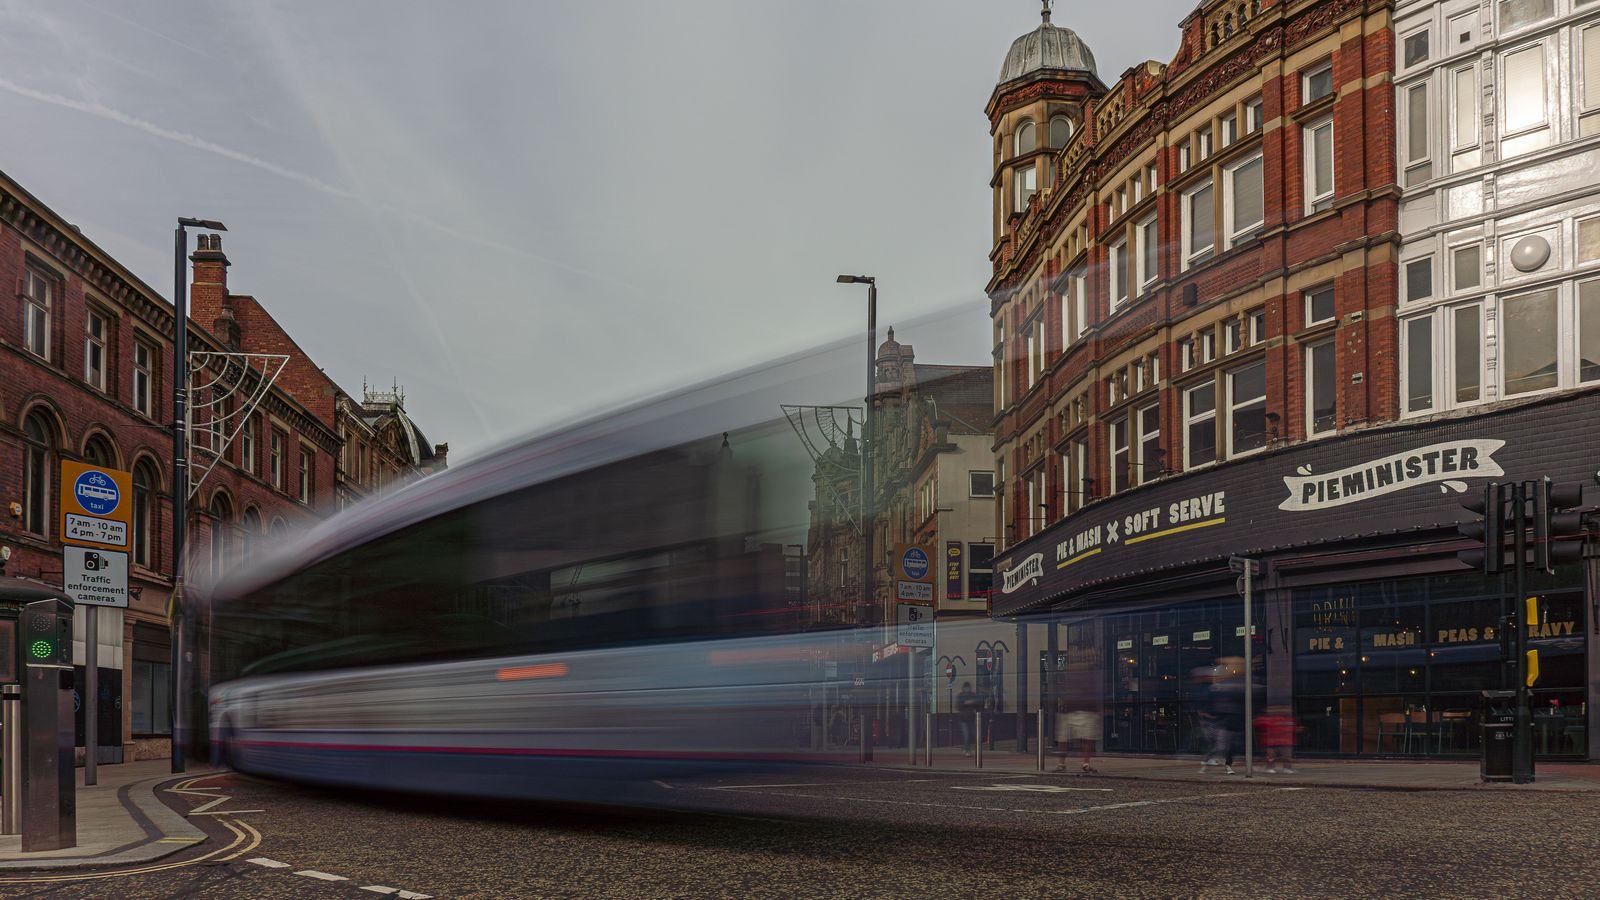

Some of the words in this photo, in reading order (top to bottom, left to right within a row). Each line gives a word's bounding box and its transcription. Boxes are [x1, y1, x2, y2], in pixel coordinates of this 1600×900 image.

[1302, 446, 1479, 504] PIEMINISTER
[90, 502, 104, 510] taxi
[97, 522, 108, 530] 10
[109, 525, 123, 533] am
[1056, 542, 1067, 562] PIE
[1068, 538, 1075, 557] &
[1076, 525, 1102, 553] MASH
[1124, 507, 1161, 536] SOFT
[1169, 491, 1225, 524] SERVE
[107, 534, 121, 543] pm
[82, 574, 111, 584] Traffic
[67, 583, 125, 595] enforcement
[78, 593, 116, 603] cameras
[1309, 637, 1330, 650] PIE
[1334, 636, 1344, 650] &
[1373, 632, 1415, 647] MASH
[1438, 627, 1479, 644] PEAS
[1483, 626, 1495, 641] &
[1527, 621, 1575, 639] RAVY
